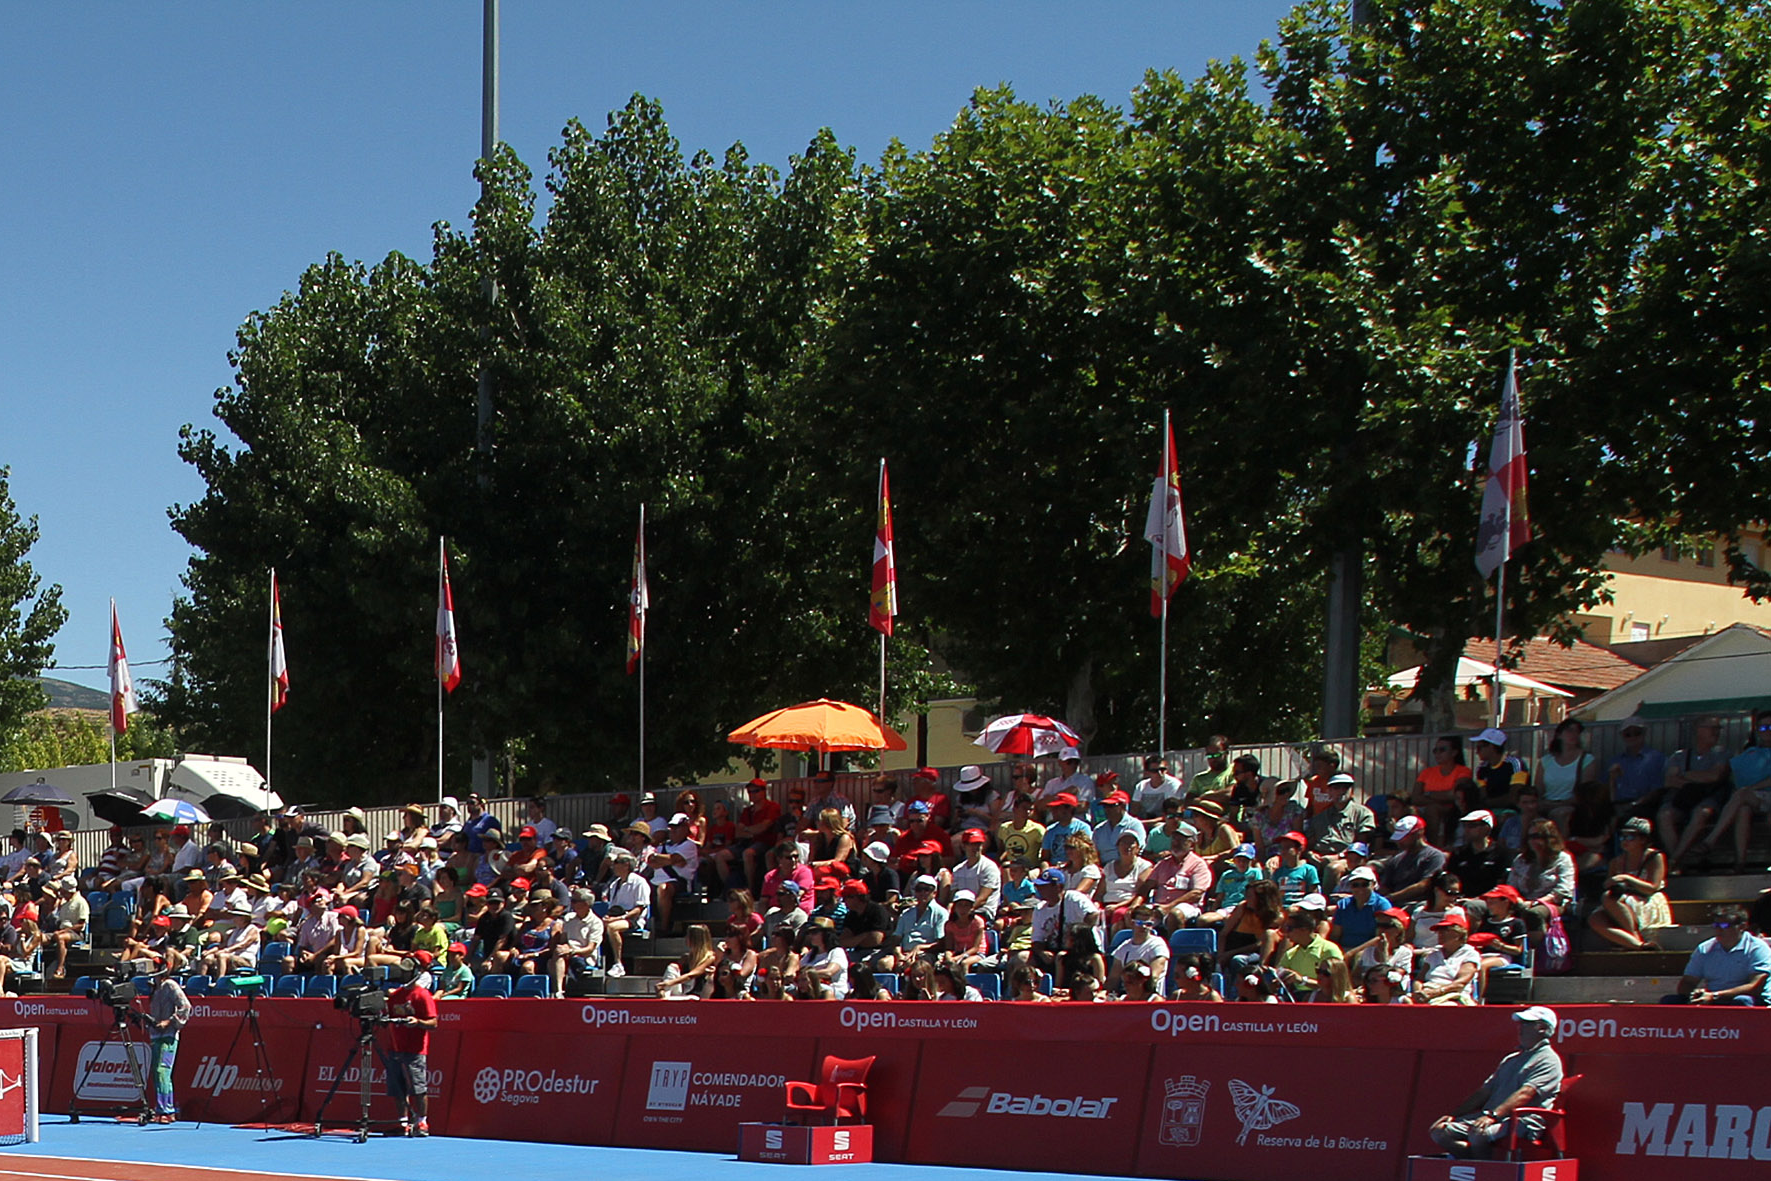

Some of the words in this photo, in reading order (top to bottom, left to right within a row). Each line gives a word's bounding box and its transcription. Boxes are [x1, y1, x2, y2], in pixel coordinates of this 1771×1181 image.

[14, 1000, 45, 1019] Open
[582, 1004, 629, 1027] Open
[631, 1015, 667, 1024] CASTILLA
[668, 1016, 674, 1024] Y
[675, 1014, 697, 1024] LEÓN
[840, 1006, 896, 1031] Open
[898, 1018, 941, 1027] CASTILLA
[942, 1019, 950, 1027] Y
[951, 1016, 977, 1028] LEÓN
[1151, 1008, 1219, 1036] Open
[1222, 1021, 1274, 1032] CASTILLA
[1277, 1023, 1284, 1032] Y
[1287, 1020, 1318, 1033] LEÓN
[1557, 1015, 1617, 1043] pen
[1621, 1027, 1684, 1038] CASTILLA
[1688, 1029, 1697, 1038] Y
[1701, 1026, 1740, 1039] LEÓN
[317, 1066, 337, 1081] EL
[502, 1069, 599, 1095] PROdestur
[655, 1069, 688, 1088] TRYP
[692, 1072, 785, 1088] COMENDADOR
[500, 1091, 539, 1105] Segovia
[690, 1090, 741, 1107] NÁYADE
[1257, 1134, 1301, 1148] Reserva
[1305, 1135, 1319, 1148] de
[1323, 1136, 1336, 1149] la
[1338, 1137, 1387, 1150] Biosfera
[829, 1153, 854, 1161] SEAT
